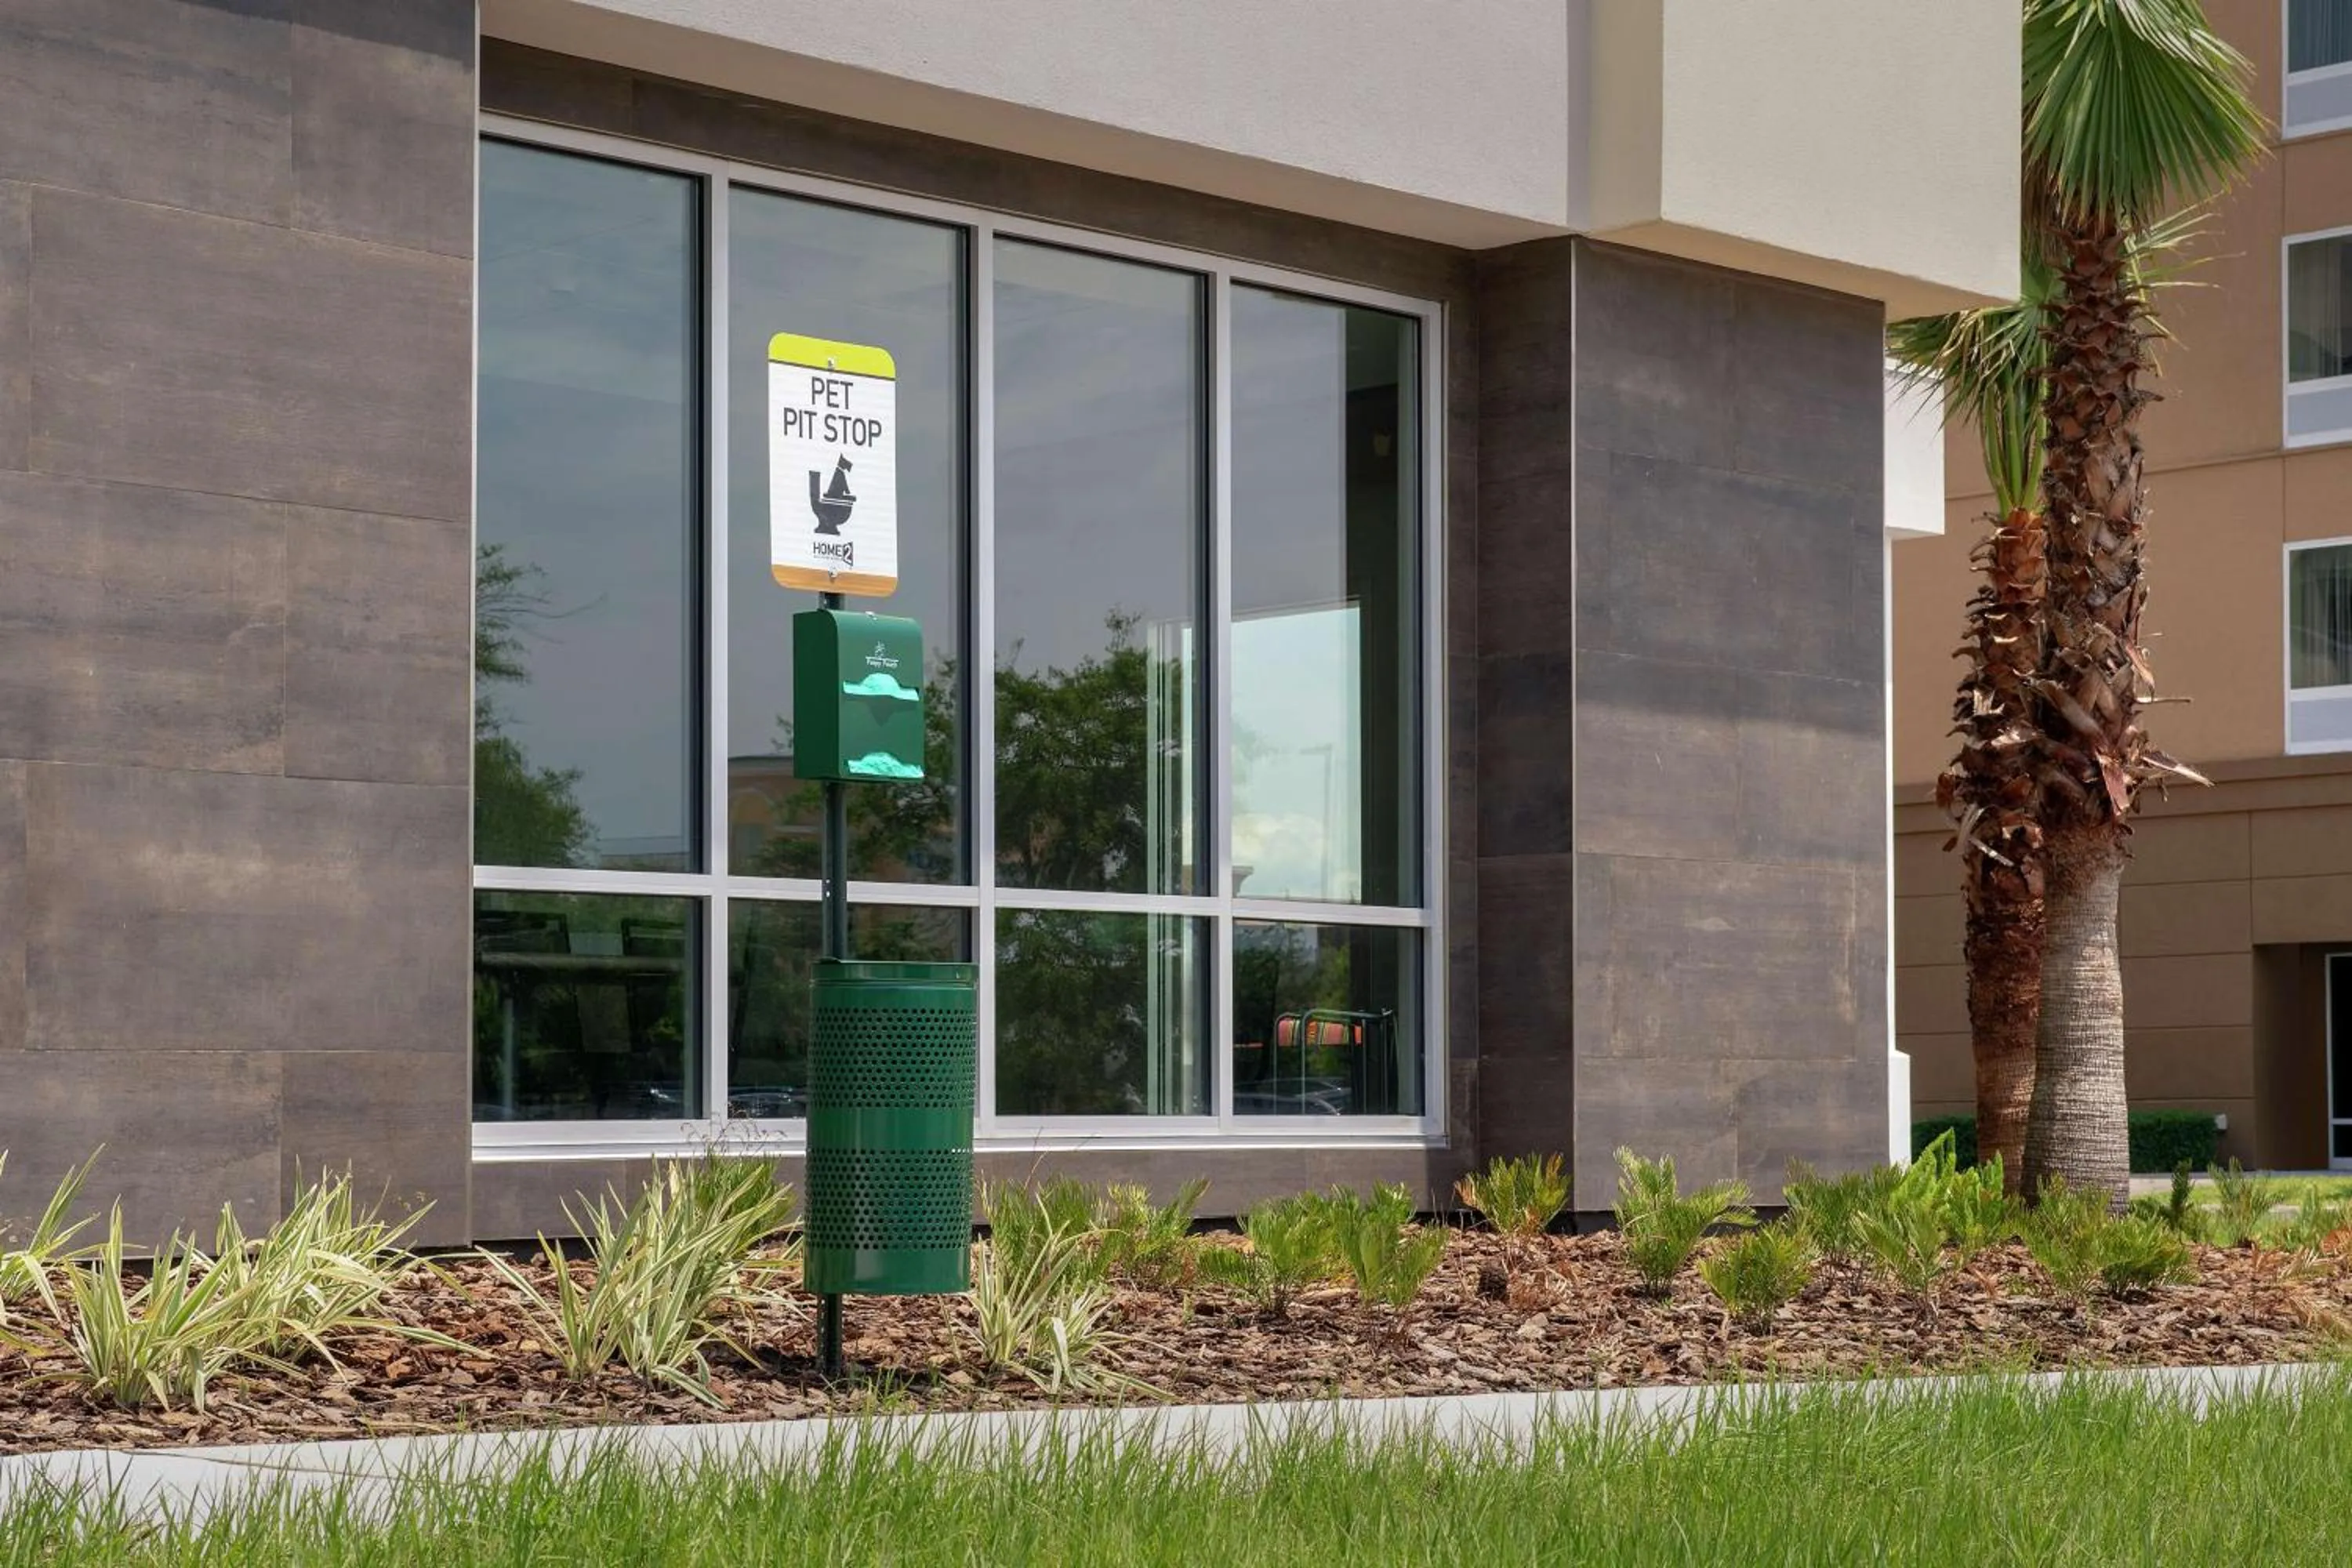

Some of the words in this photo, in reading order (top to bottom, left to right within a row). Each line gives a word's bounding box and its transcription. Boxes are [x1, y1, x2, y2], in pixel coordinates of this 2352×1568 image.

[811, 376, 854, 409] PET
[784, 407, 817, 440] PIT
[824, 413, 882, 448] STOP
